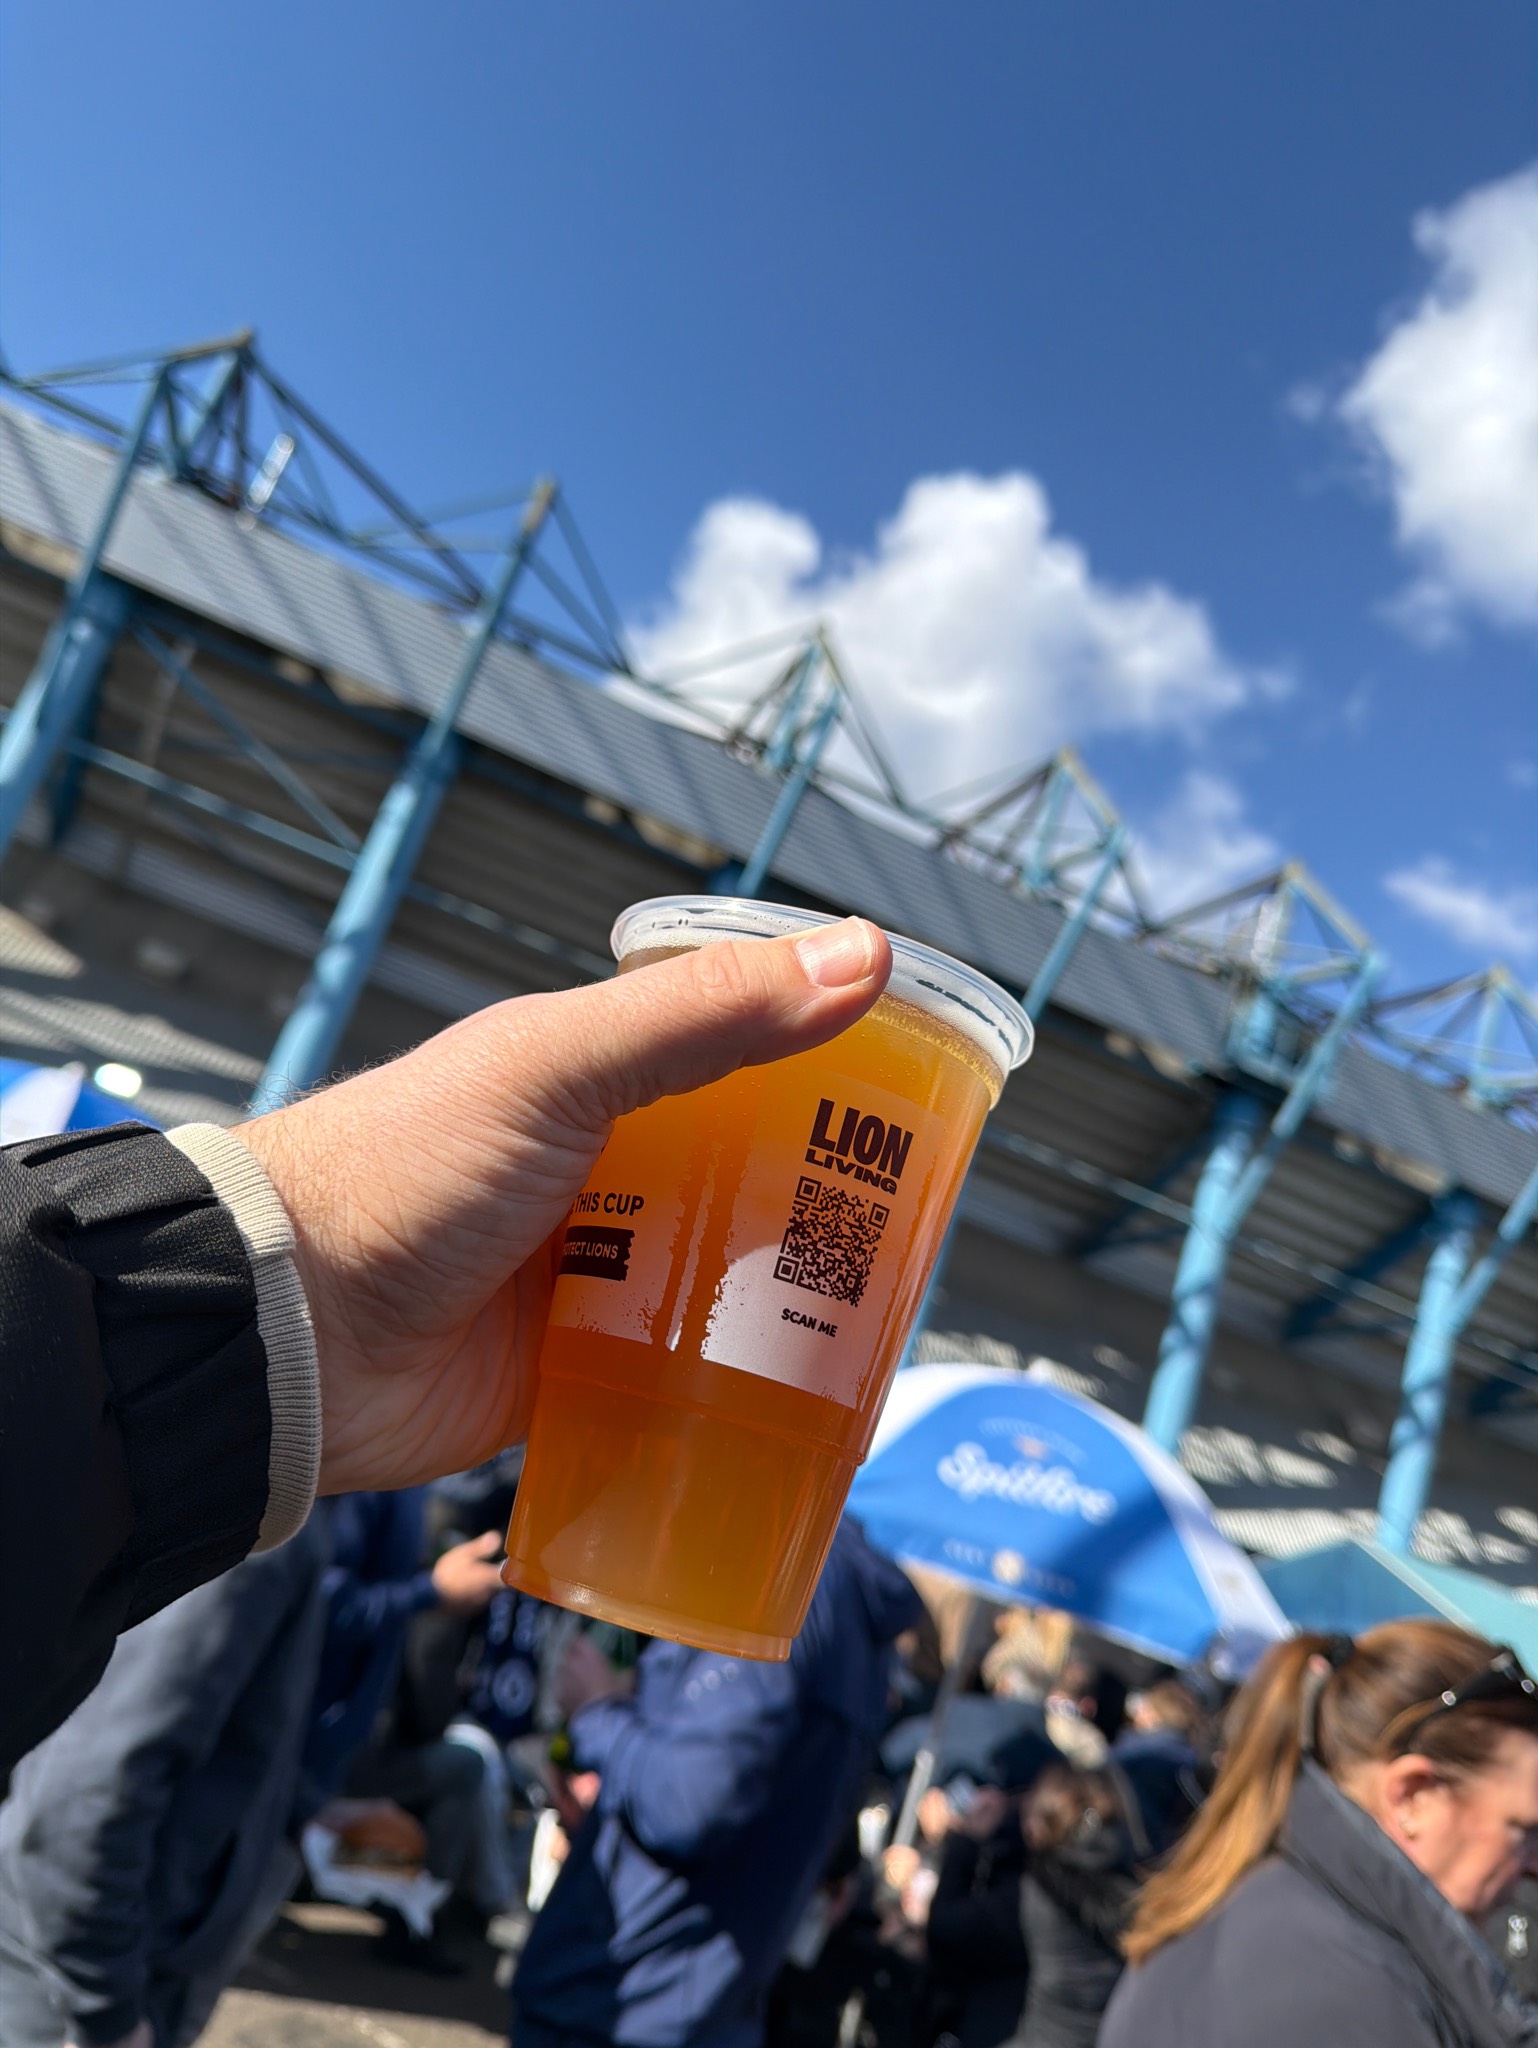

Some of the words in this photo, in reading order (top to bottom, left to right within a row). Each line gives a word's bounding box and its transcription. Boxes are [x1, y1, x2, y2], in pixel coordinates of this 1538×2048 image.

[809, 1098, 914, 1179] LION
[804, 1148, 898, 1196] LIVING
[575, 1192, 600, 1213] THIS
[603, 1192, 645, 1216] CUP
[586, 1242, 619, 1260] LIONS
[781, 1308, 817, 1330] SCAN
[817, 1320, 838, 1338] ME
